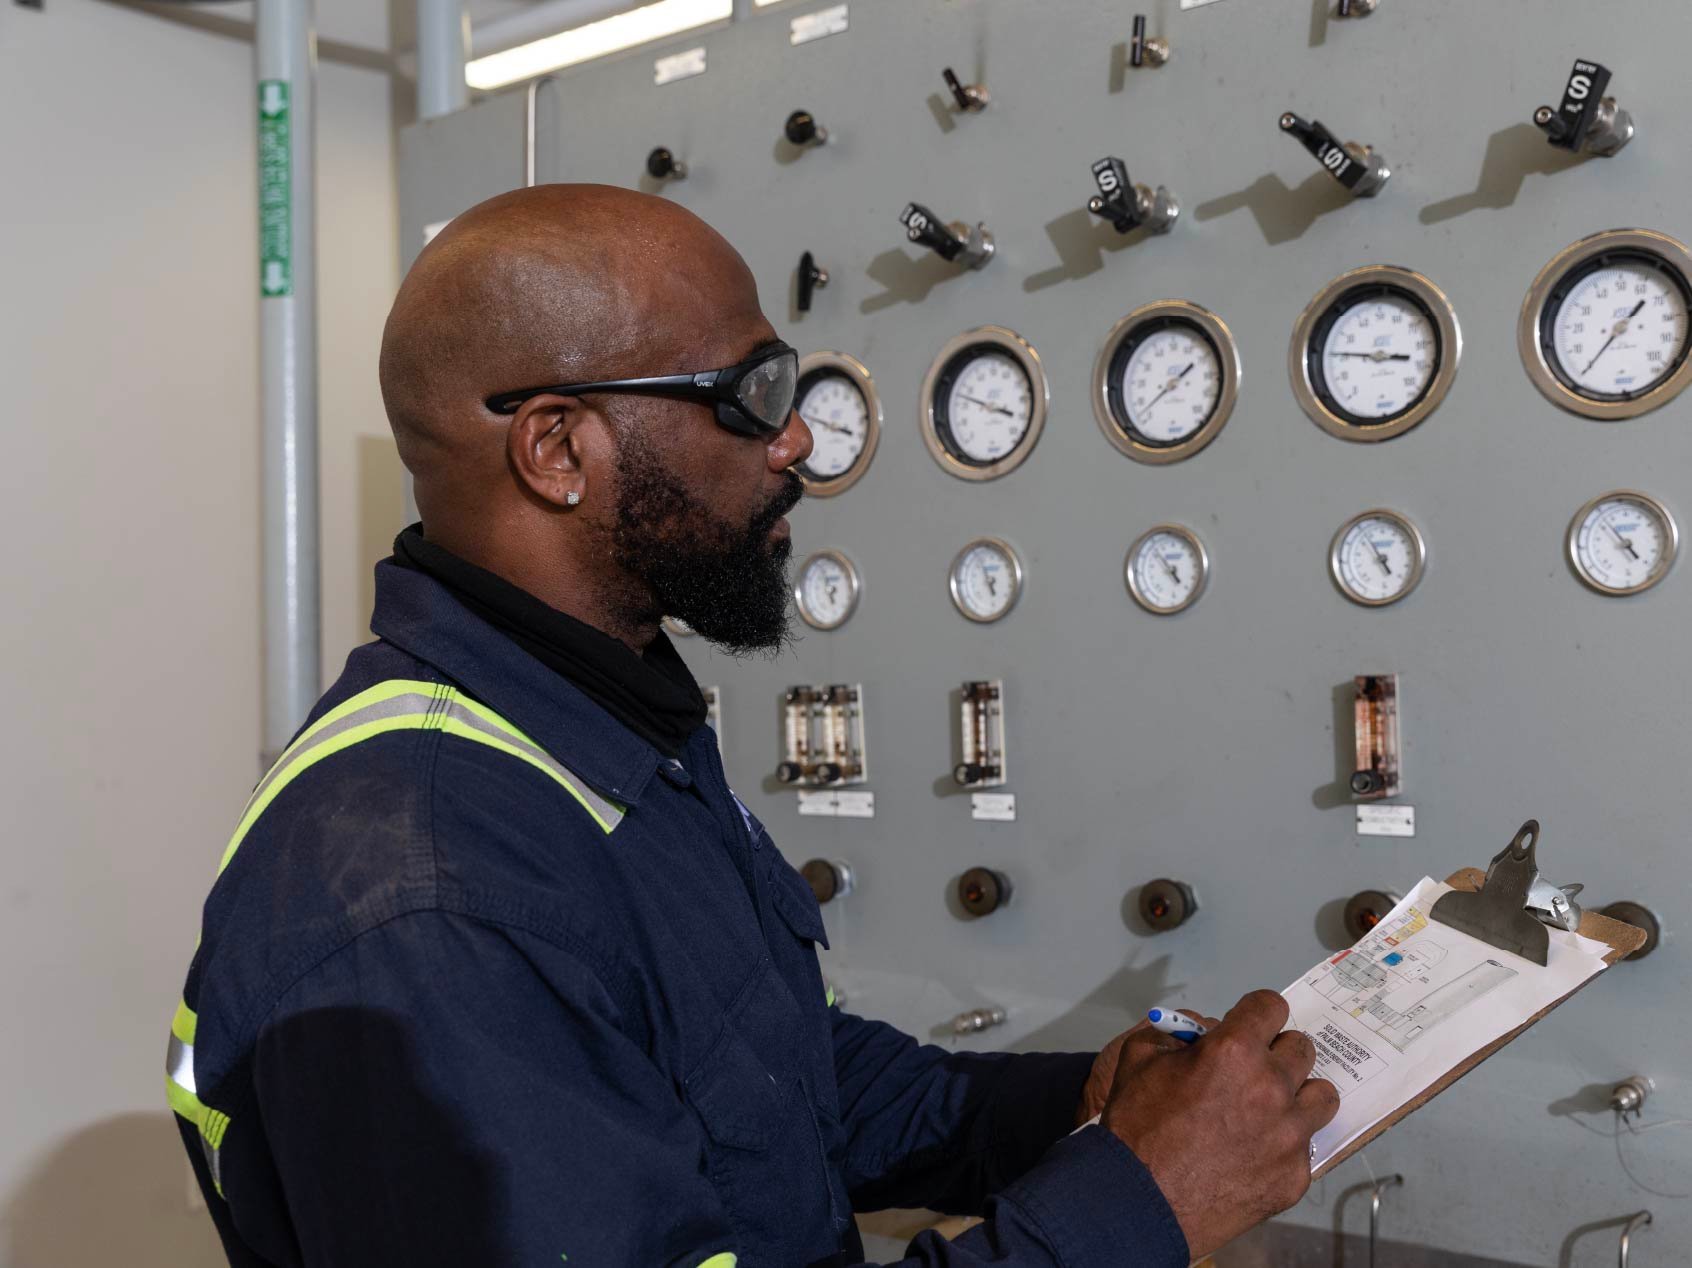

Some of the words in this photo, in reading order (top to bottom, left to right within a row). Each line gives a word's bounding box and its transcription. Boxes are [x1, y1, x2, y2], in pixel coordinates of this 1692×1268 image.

[1567, 74, 1592, 100] S
[1323, 147, 1345, 170] S
[1098, 169, 1118, 192] S
[1320, 1032, 1334, 1044] PALM
[1329, 1040, 1346, 1054] BEACH
[1342, 1050, 1362, 1066] COUNTY
[1324, 1024, 1338, 1034] SOLID
[1334, 1032, 1350, 1045] WASTE
[1346, 1041, 1372, 1062] AUTHORITY
